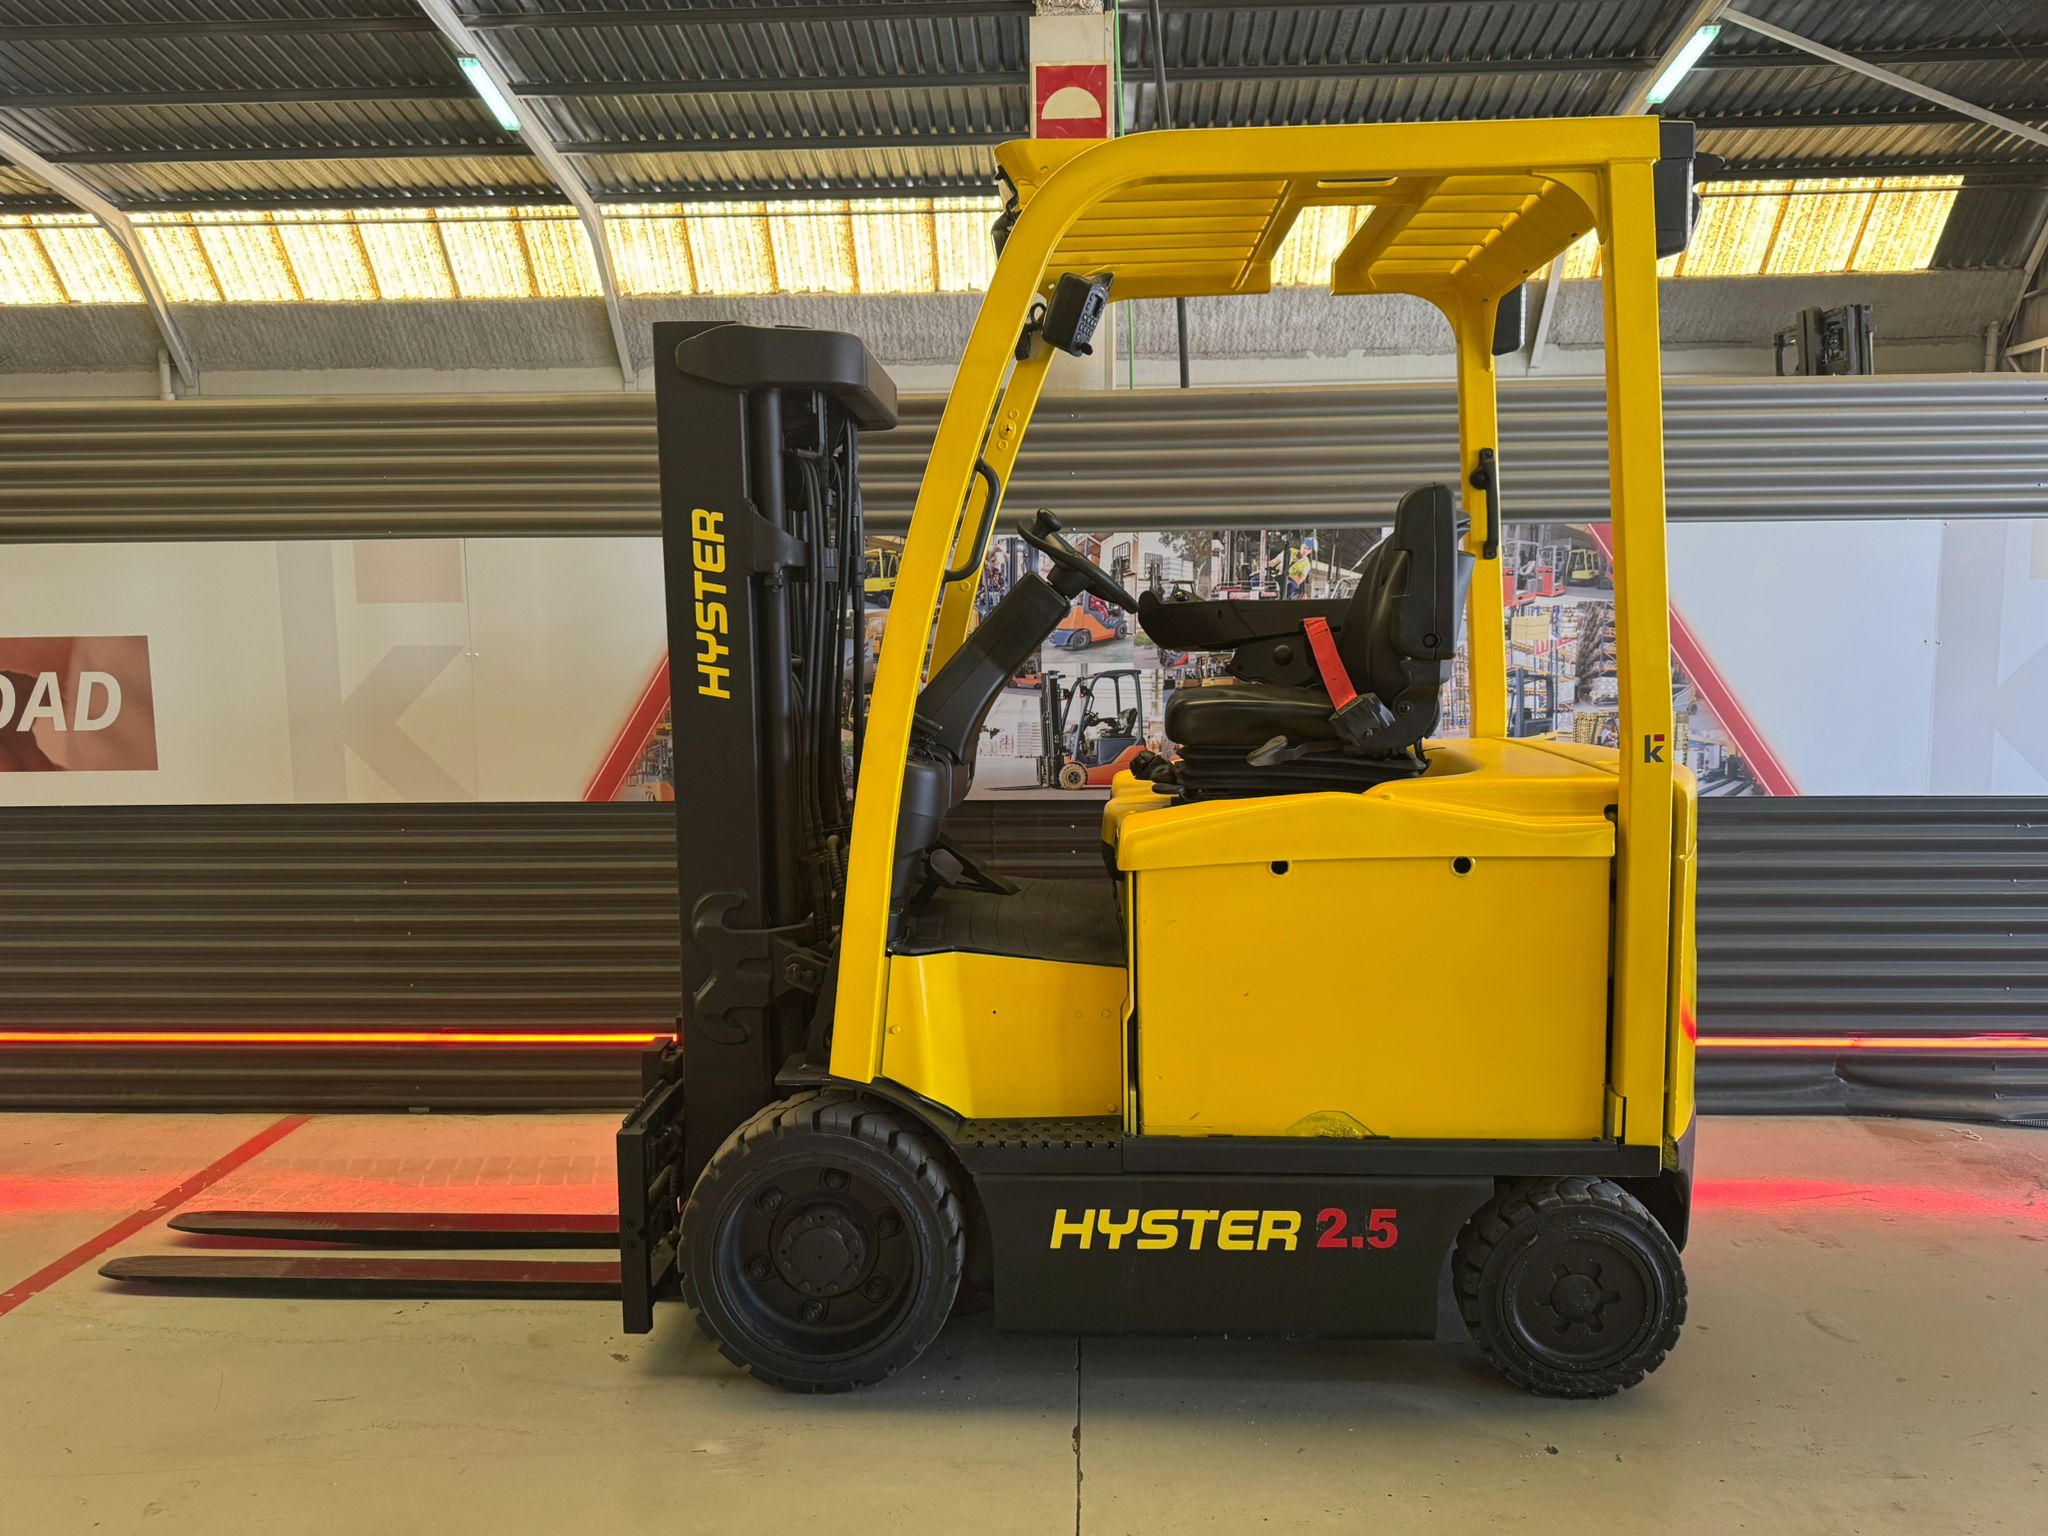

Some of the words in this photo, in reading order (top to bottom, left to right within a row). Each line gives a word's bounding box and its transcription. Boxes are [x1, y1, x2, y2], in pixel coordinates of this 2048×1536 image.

[691, 507, 731, 700] HYSTER
[1051, 1208, 1300, 1251] HYSTER
[1316, 1207, 1399, 1249] 2.5
